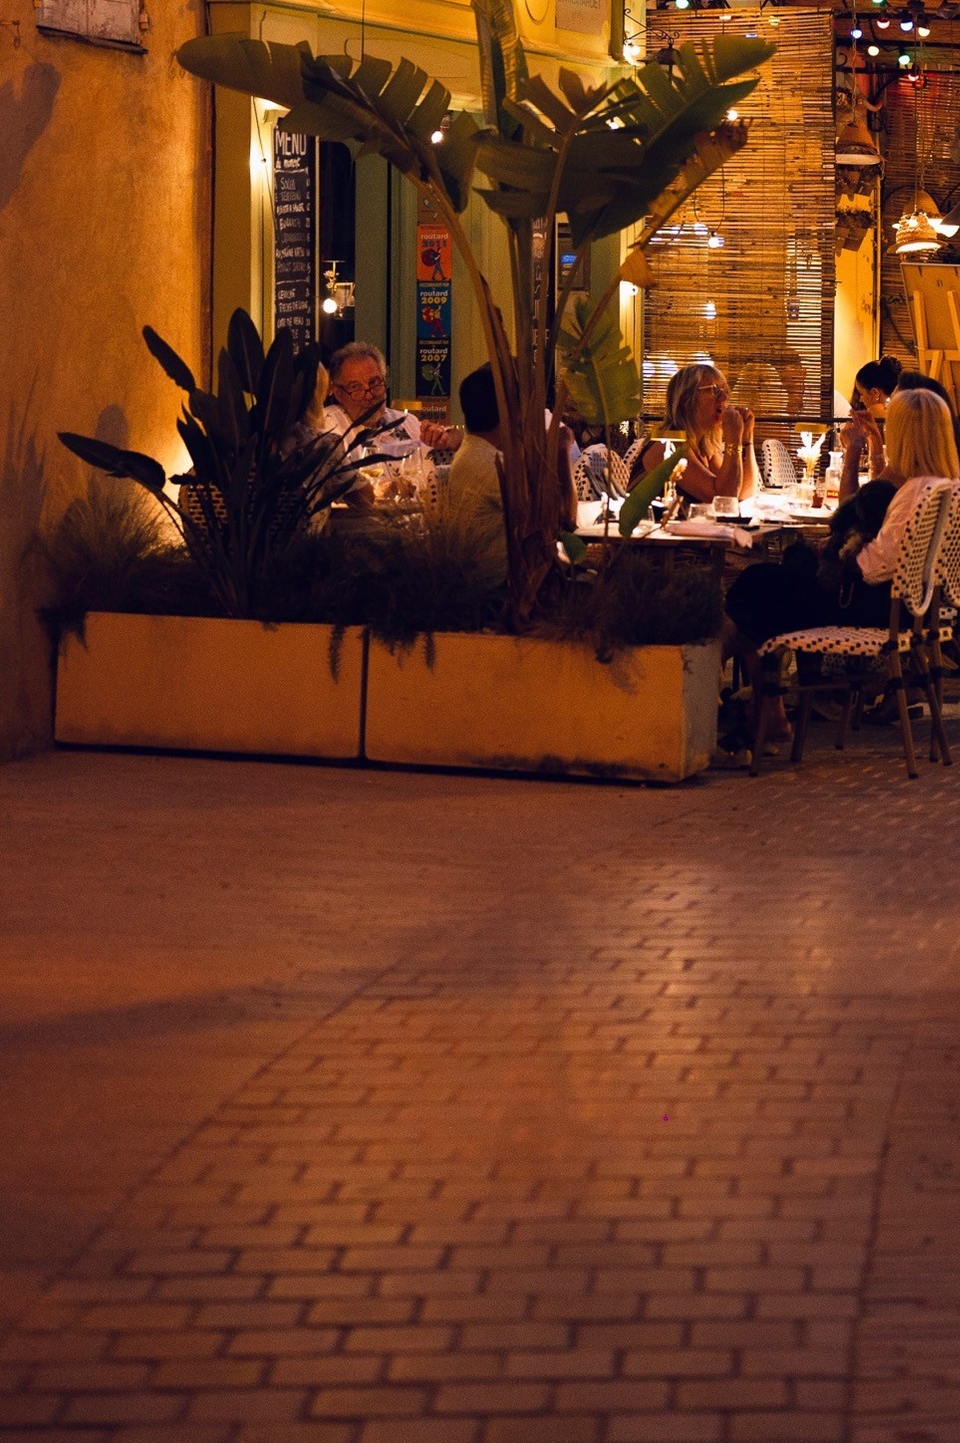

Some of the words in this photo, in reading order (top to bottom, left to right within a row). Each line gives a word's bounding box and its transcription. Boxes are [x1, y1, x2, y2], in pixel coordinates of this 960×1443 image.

[275, 131, 307, 156] MENU
[422, 240, 447, 248] 2011
[421, 296, 448, 305] 2009
[420, 347, 448, 355] routard
[421, 354, 447, 363] 2007
